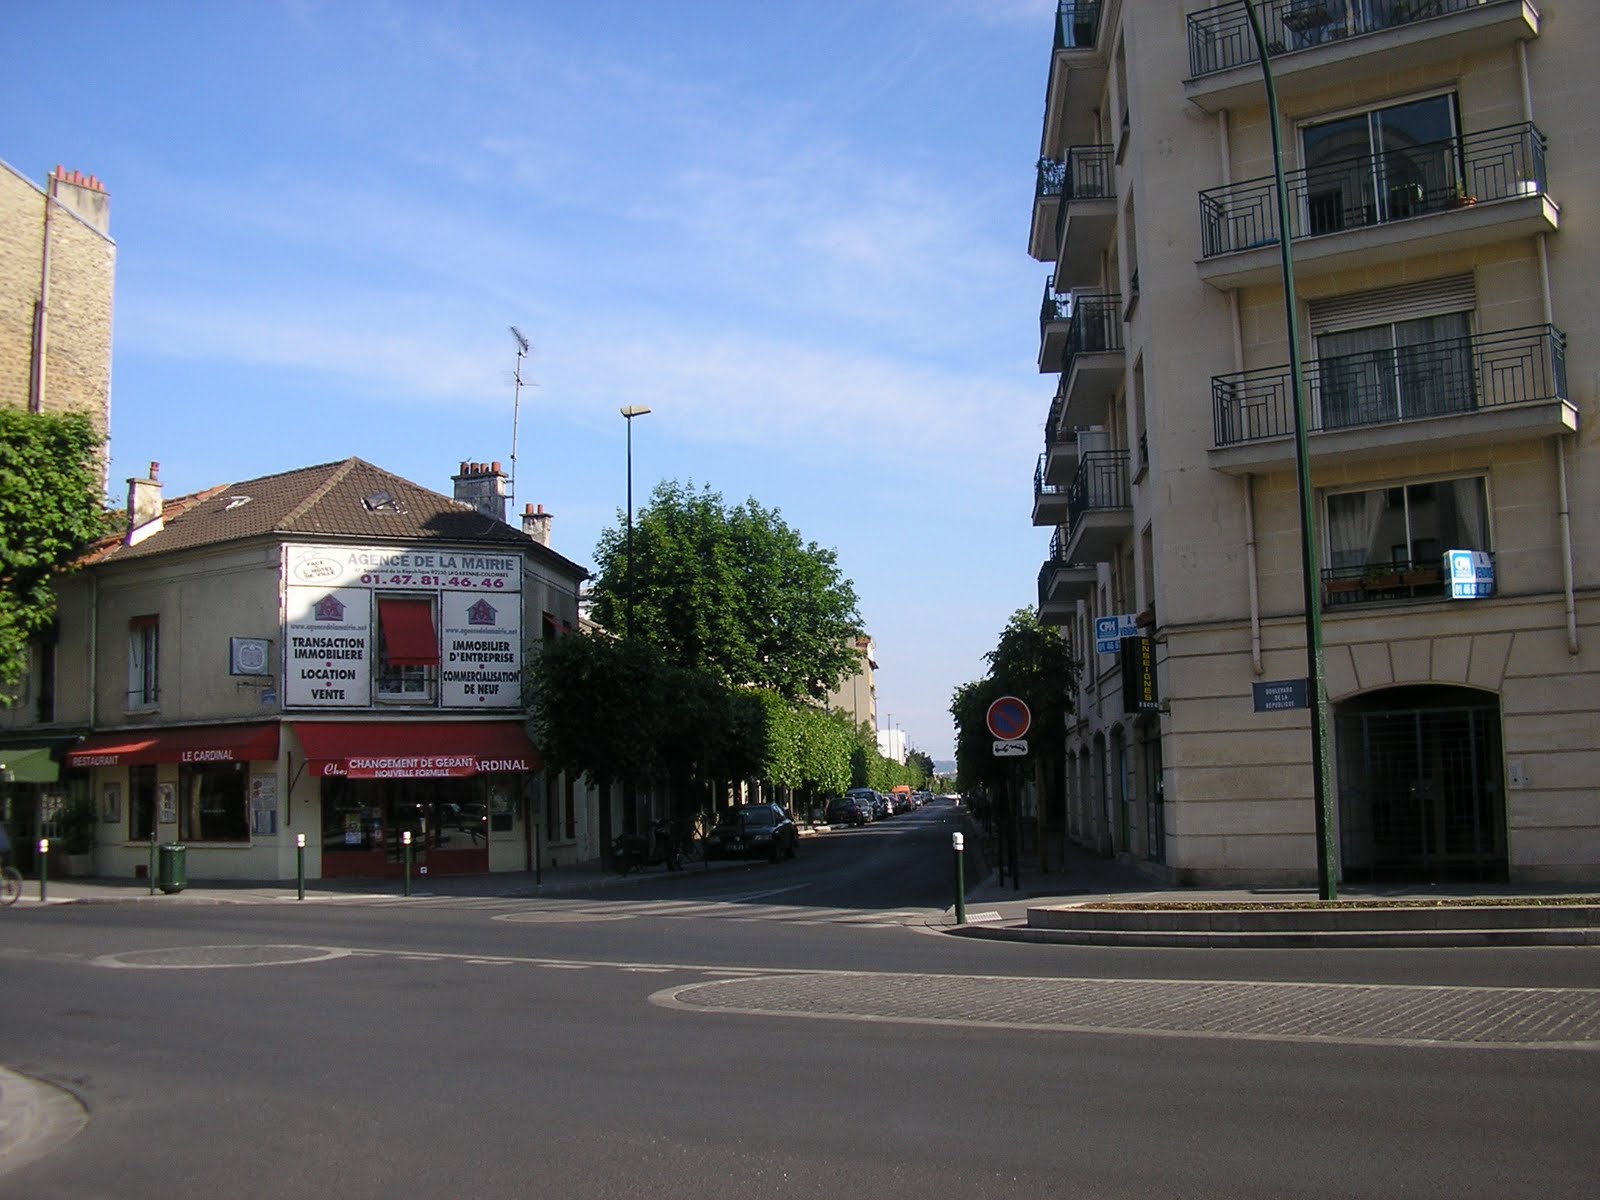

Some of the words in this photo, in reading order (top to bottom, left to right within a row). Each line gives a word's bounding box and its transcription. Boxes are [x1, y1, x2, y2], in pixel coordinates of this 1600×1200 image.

[348, 553, 410, 567] AGENCE
[414, 555, 434, 568] DE
[439, 556, 457, 569] LA
[461, 557, 514, 571] MAIRIE
[292, 637, 364, 648] TRANSACTION
[453, 641, 510, 651] IMMOBILIER
[294, 649, 363, 660] IMMOBILIERE
[449, 652, 514, 663] D'ENTREPRISE
[301, 669, 356, 680] LOCATION
[1141, 638, 1152, 702] ENSEIGNES
[443, 671, 519, 682] COMMERCIALISATION
[311, 689, 345, 700] VENTE
[464, 684, 475, 694] DE
[478, 684, 499, 694] NEUF
[1265, 686, 1293, 695] BOULEVARD
[72, 755, 119, 767] RESTAURANT
[182, 751, 193, 762] LE
[193, 750, 234, 762] CARDINAL
[349, 758, 419, 769] CHANGEMENT
[420, 758, 433, 768] DE
[435, 758, 473, 768] GERANT
[475, 760, 529, 771] ARDINAL
[374, 769, 414, 778] NOUVELLE
[415, 768, 450, 777] FORMULE
